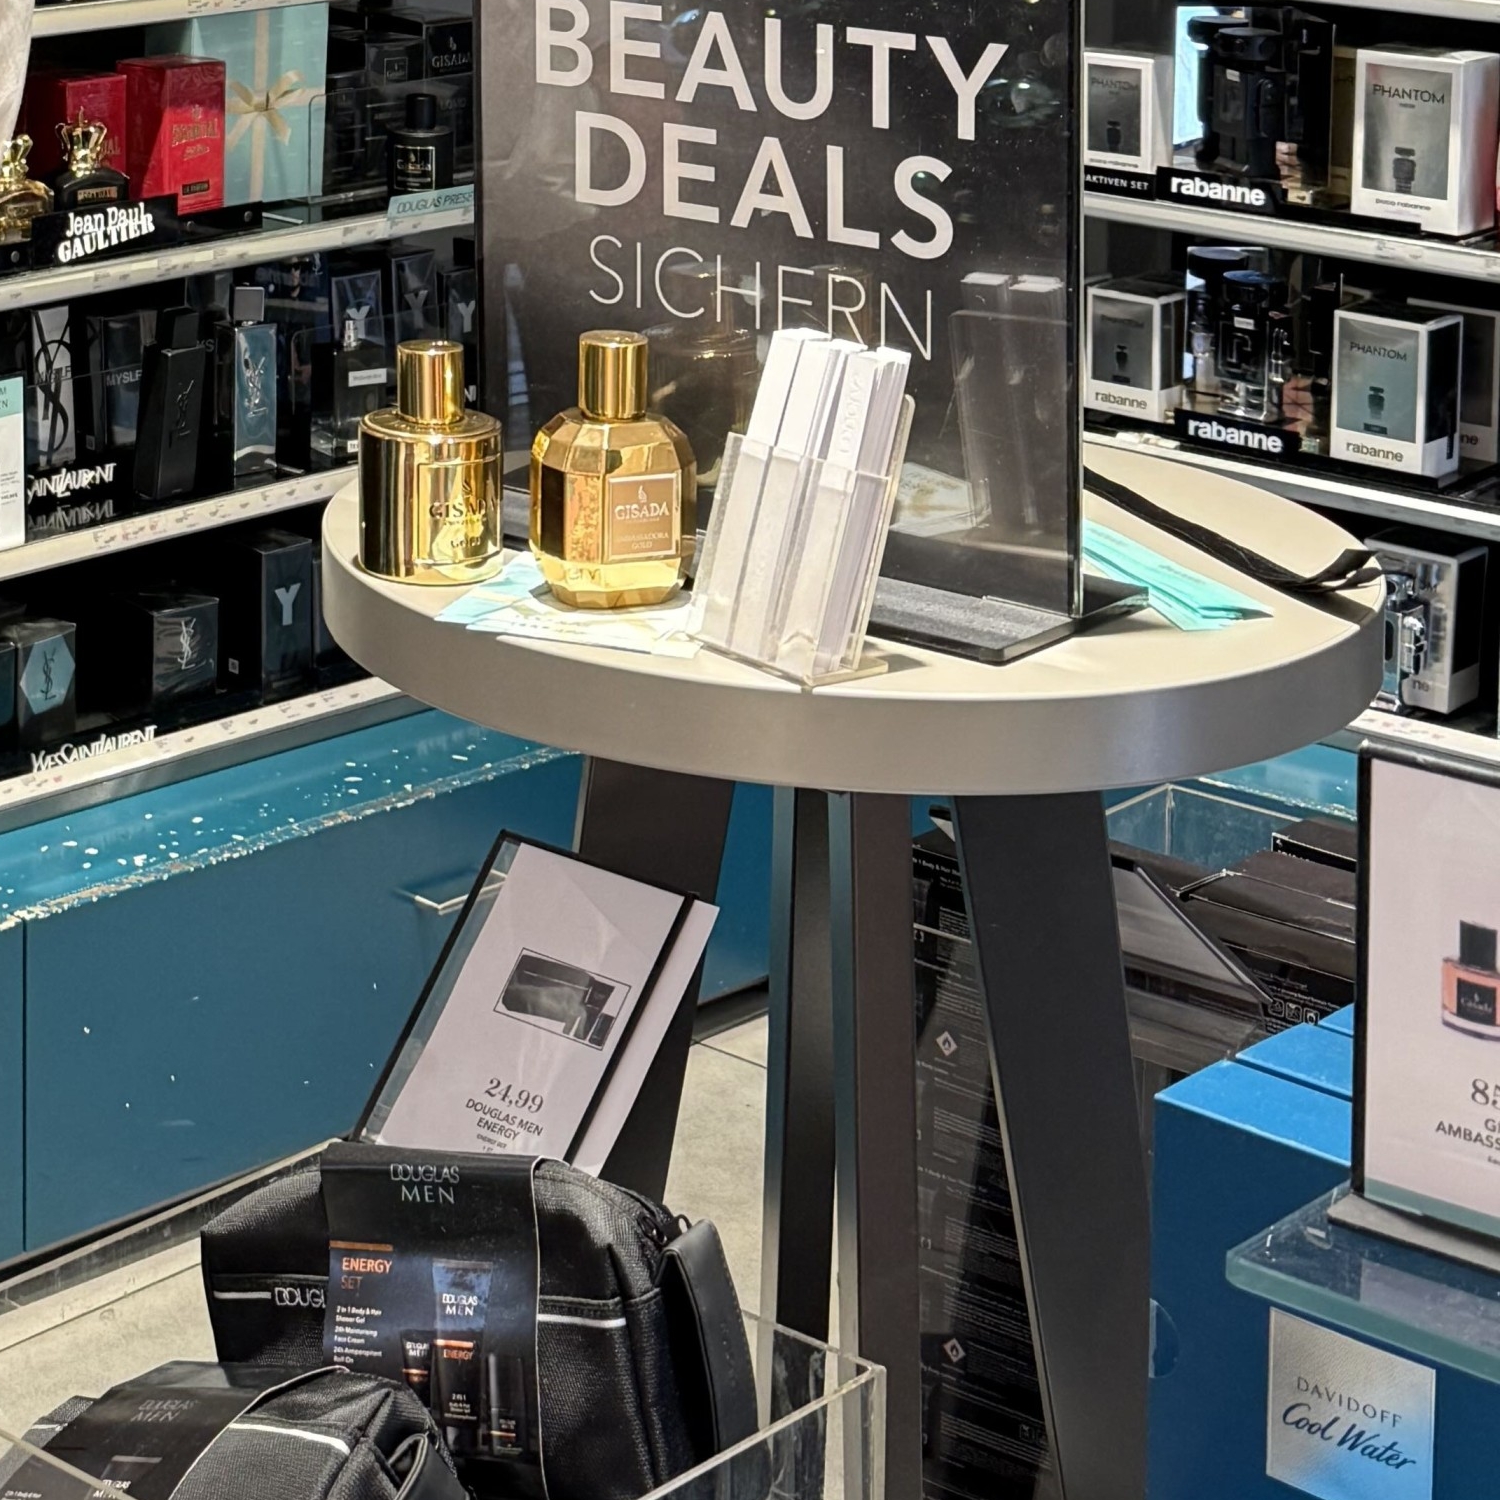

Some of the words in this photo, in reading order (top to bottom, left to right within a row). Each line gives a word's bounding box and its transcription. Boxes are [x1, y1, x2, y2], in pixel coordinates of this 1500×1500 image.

[1089, 76, 1140, 92] PHANTOM
[1372, 83, 1445, 106] PHANTOM
[574, 110, 954, 260] DEALS
[1130, 178, 1148, 191] SET
[1170, 175, 1266, 207] rabanne
[397, 195, 442, 214] DOUGLAS
[1396, 201, 1432, 212] rabanne
[66, 212, 107, 238] Jean
[107, 204, 146, 230] Paul
[57, 219, 156, 264] GAULTIER
[588, 234, 932, 361] SICHERN
[457, 300, 475, 333] Y
[1348, 340, 1409, 362] PHANTOM
[1094, 390, 1148, 411] rabanne
[1187, 415, 1284, 454] rabanne
[1345, 439, 1405, 464] rabanne
[614, 503, 670, 521] GISADA
[631, 541, 653, 550] GOLD
[275, 583, 300, 627] Y
[484, 1077, 544, 1113] 24,99
[465, 1098, 518, 1126] DOUGLAS
[517, 1119, 543, 1136] MEN
[476, 1117, 520, 1141] ENERGY
[390, 1163, 460, 1184] DOUGLAS
[401, 1184, 455, 1204] MEN
[341, 1257, 393, 1275] ENERGY
[340, 1275, 363, 1290] SET
[442, 1294, 478, 1304] DOUGLAS
[446, 1307, 474, 1316] MEN
[443, 1350, 474, 1360] ENERGY
[1295, 1376, 1402, 1429] DAVIDOFF
[131, 1411, 181, 1422] MEN
[1281, 1401, 1335, 1446] Cool
[1336, 1421, 1417, 1472] Water
